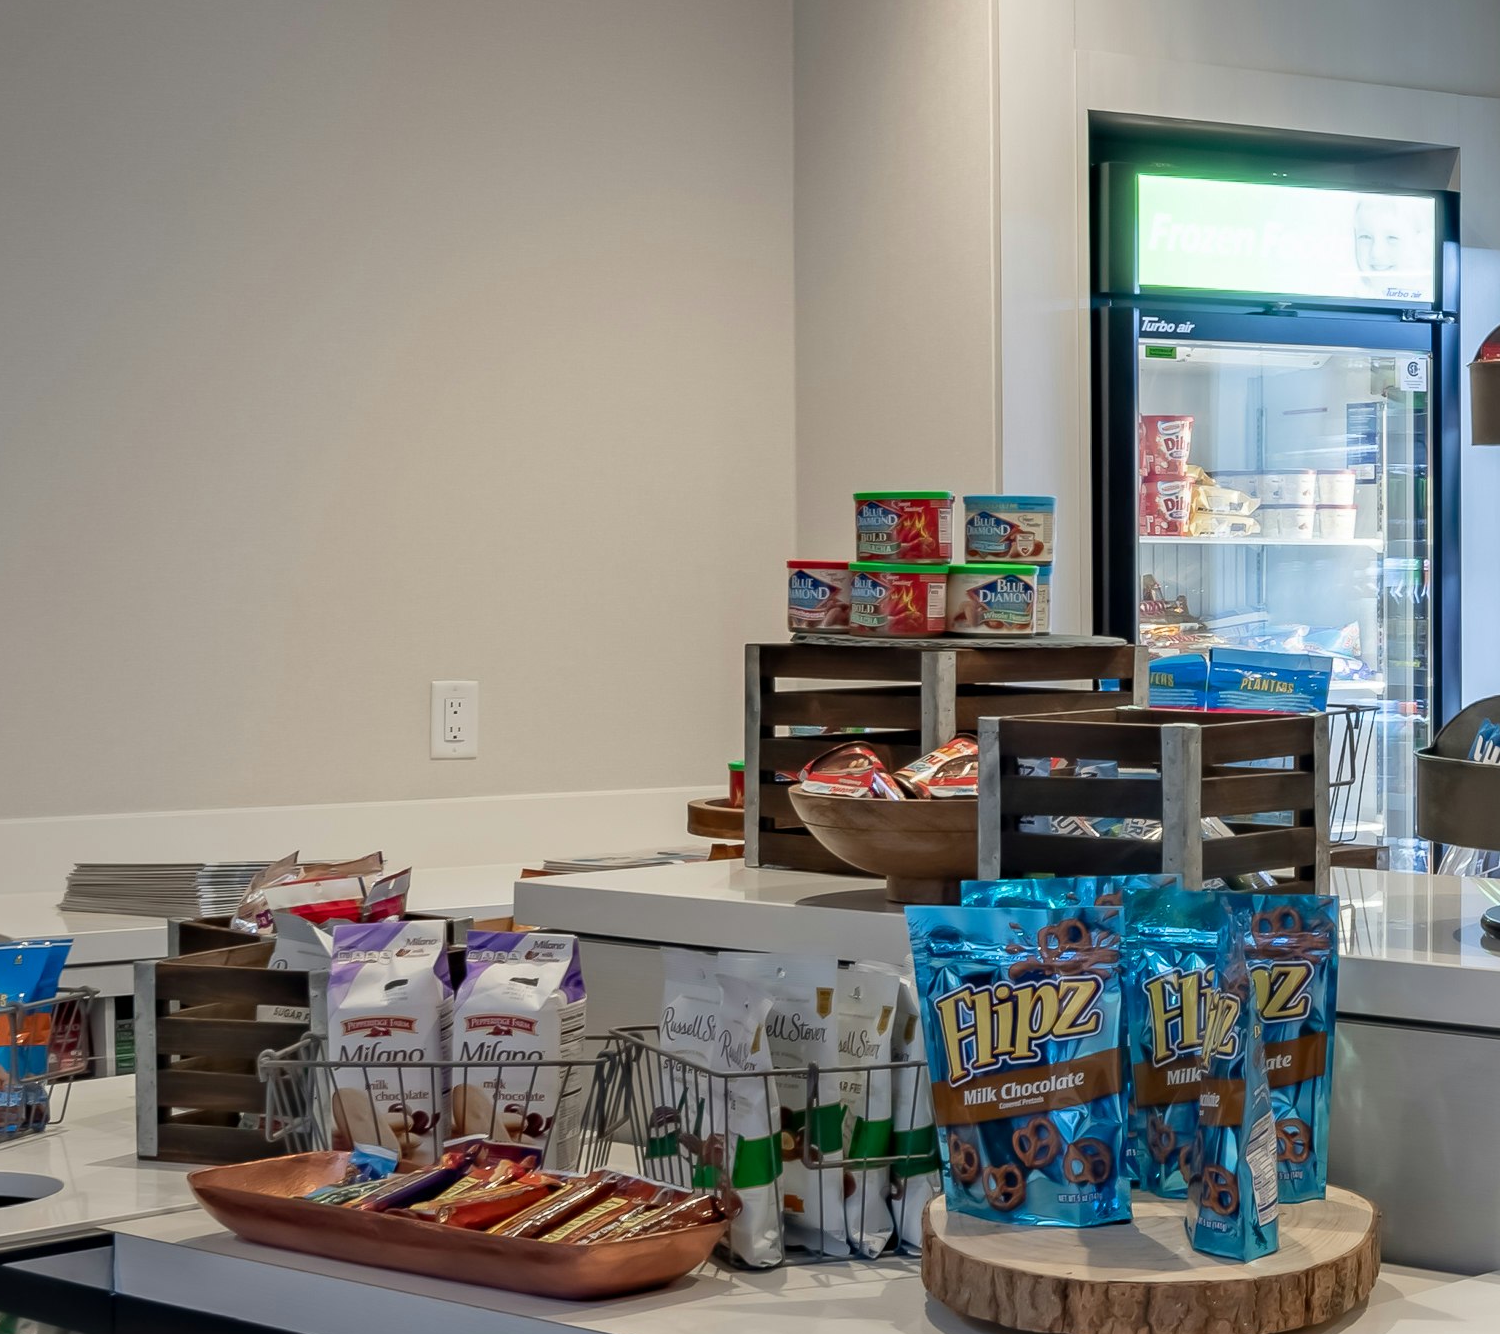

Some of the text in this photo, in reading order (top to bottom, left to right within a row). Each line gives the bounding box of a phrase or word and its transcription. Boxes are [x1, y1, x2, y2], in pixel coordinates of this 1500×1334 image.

[1385, 287, 1422, 299] Turbo air
[1141, 317, 1195, 334] Turbo air
[862, 506, 884, 517] BLUE
[858, 514, 898, 526] DIAMOND
[974, 515, 998, 527] BLUE
[967, 524, 1011, 536] DIAMOND
[861, 532, 887, 542] BOLD
[791, 578, 814, 590] BLUE
[854, 578, 873, 590] BLUE
[997, 579, 1024, 593] BLUE
[979, 589, 1034, 603] DIAMOND
[1240, 677, 1295, 695] PLANTERS
[406, 937, 438, 947] Milano
[533, 940, 565, 950] Milano
[273, 1006, 303, 1021] SUGAR
[347, 1018, 412, 1030] PEPPERIDGE FARM
[470, 1018, 532, 1029] PEPPERIDGE FARM
[787, 1013, 827, 1044] Stover
[934, 976, 1103, 1085] Flipz
[340, 1041, 425, 1063] Milano
[461, 1040, 544, 1063] Milano
[1167, 1068, 1201, 1086] Milk
[365, 1079, 388, 1091] milk
[483, 1078, 506, 1091] milk
[963, 1070, 1085, 1106] Milk Chocolate
[375, 1089, 429, 1102] chocolate
[493, 1090, 545, 1102] chocolate
